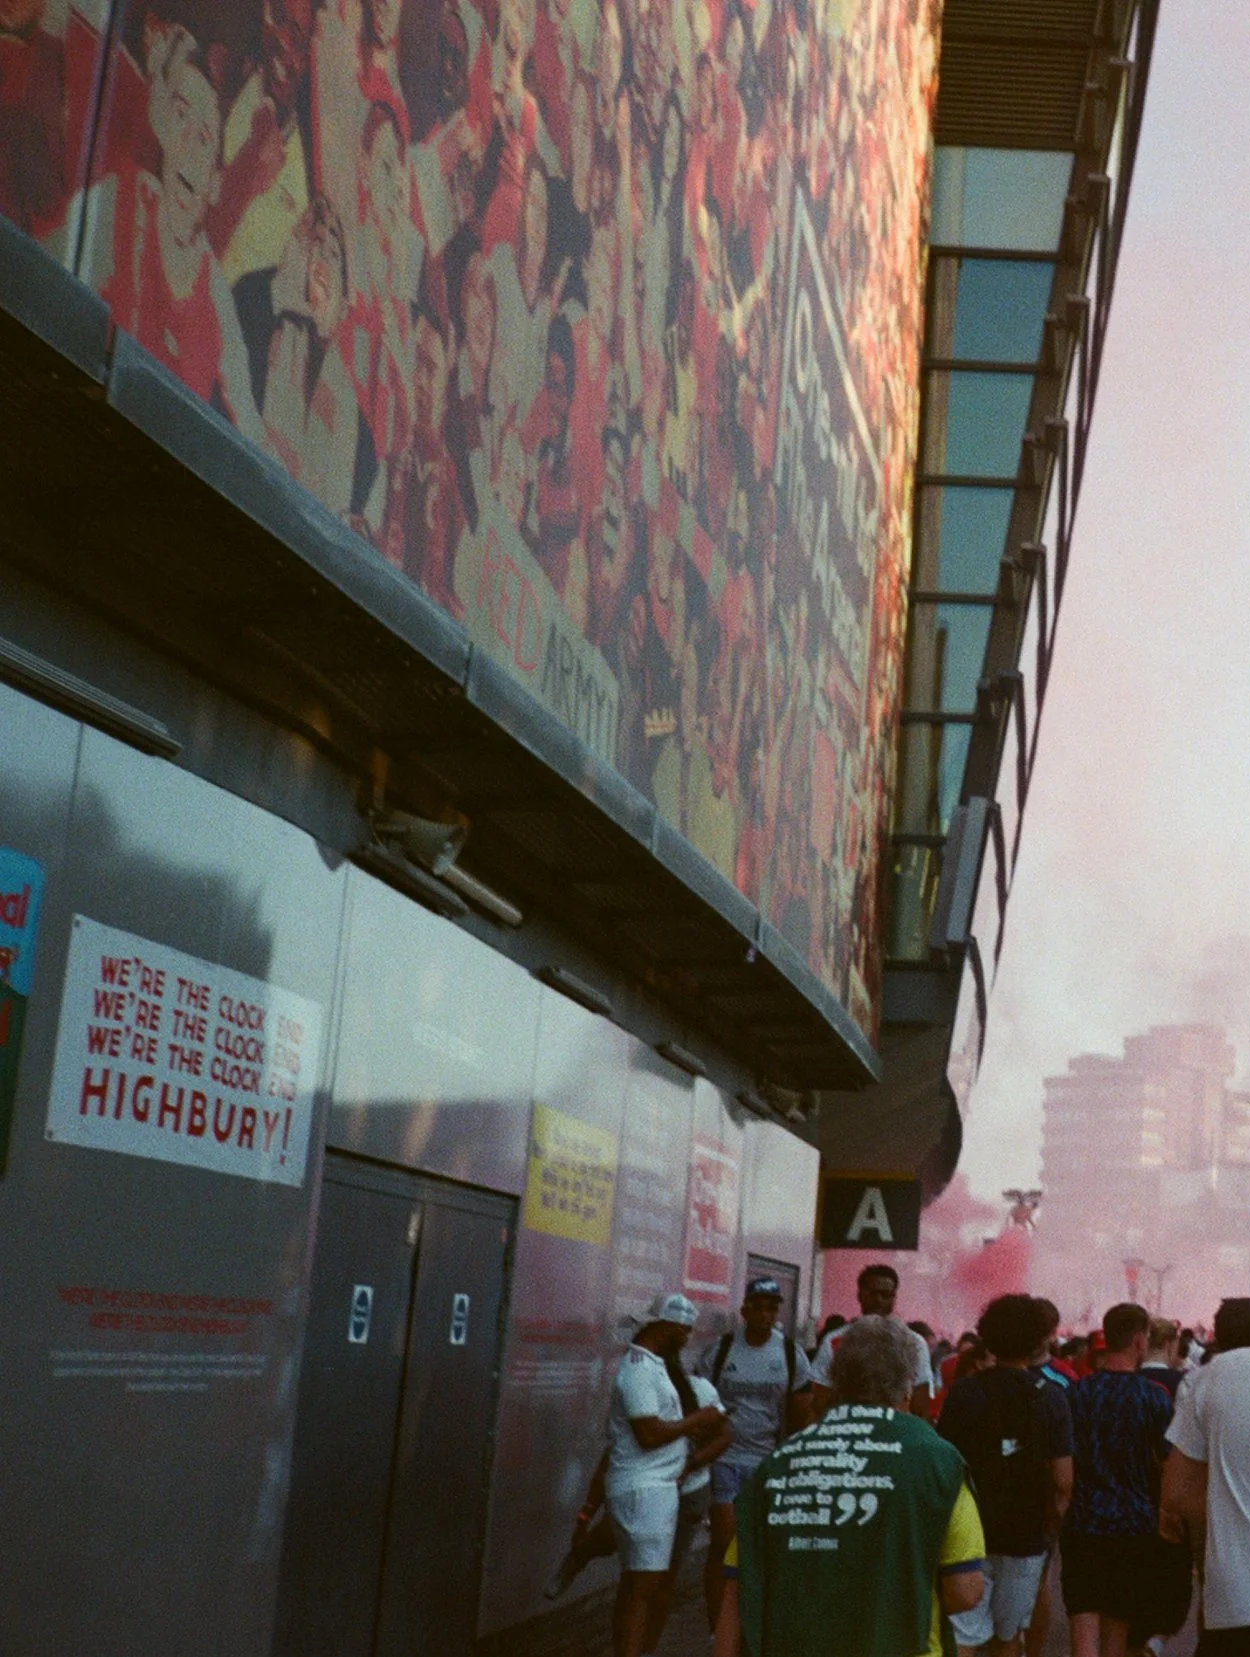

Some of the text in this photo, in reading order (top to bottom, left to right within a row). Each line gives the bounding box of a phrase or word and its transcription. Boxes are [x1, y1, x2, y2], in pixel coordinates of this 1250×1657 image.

[476, 524, 543, 672] RED
[101, 955, 166, 998] WE'RE
[177, 976, 211, 1012] THE
[218, 995, 267, 1032] CLOCK
[94, 987, 162, 1032] WE'RE
[173, 1009, 208, 1043] THE
[214, 1026, 265, 1064] CLOCK
[87, 1024, 158, 1065] WE'RE
[168, 1043, 204, 1076] THE
[210, 1056, 262, 1096] CLOCK
[79, 1067, 293, 1166] HIGHBURY!
[846, 1186, 894, 1242] A
[823, 1403, 850, 1422] All
[789, 1451, 869, 1472] morality
[852, 1438, 902, 1453] about
[788, 1470, 895, 1490] obligations,
[767, 1507, 832, 1526] ootball
